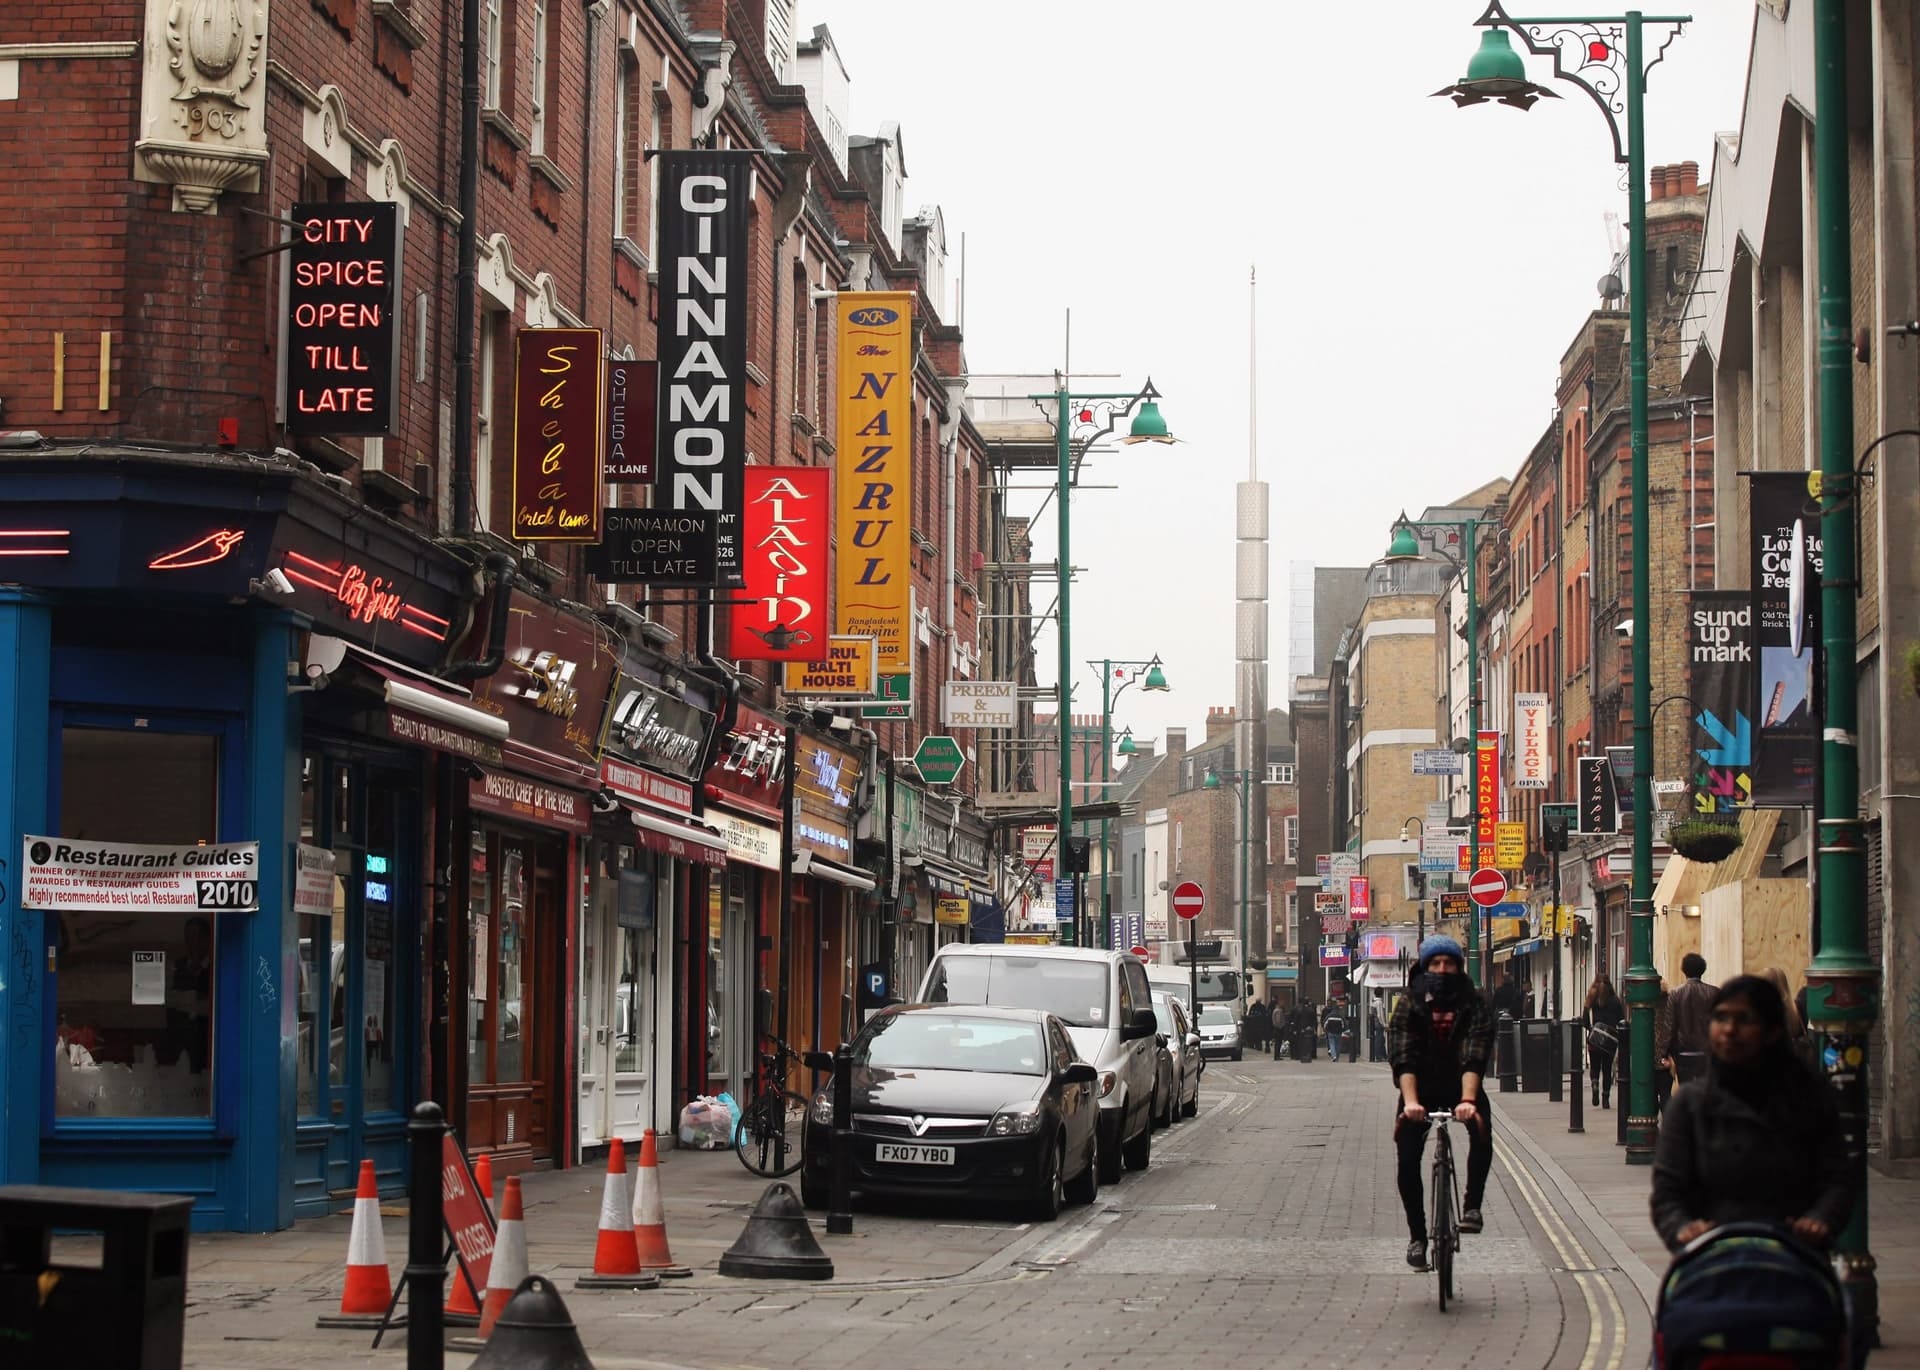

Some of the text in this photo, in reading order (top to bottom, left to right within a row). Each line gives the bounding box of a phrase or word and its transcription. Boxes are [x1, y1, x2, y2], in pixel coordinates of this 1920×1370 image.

[181, 106, 237, 138] 1903
[304, 218, 374, 243] CITY
[296, 260, 385, 286] SPICE
[296, 303, 379, 328] OPEN
[858, 310, 889, 324] NR
[670, 176, 730, 510] CINNAMON
[856, 344, 891, 356] The
[305, 345, 369, 371] TILL
[298, 388, 374, 412] LATE
[539, 346, 578, 500] Sheba
[612, 368, 626, 459] SHEBA
[620, 465, 648, 473] LANE
[850, 372, 897, 586] NAZRUL
[517, 505, 590, 528] brick lane
[608, 516, 705, 533] CINNAMON
[1777, 527, 1793, 537] Th
[632, 539, 681, 553] OPEN
[610, 559, 697, 575] TILL LATE
[338, 565, 368, 620] City
[848, 617, 899, 625] Bangladeshi
[1762, 620, 1784, 628] Brick
[848, 625, 899, 637] Cuisine
[1700, 626, 1731, 648] up
[808, 662, 851, 673] BALTI
[802, 676, 856, 687] HOUSE
[951, 685, 1010, 696] PREEM
[974, 699, 987, 710] &
[950, 712, 1011, 724] PRITHI
[1524, 709, 1540, 778] VILLAGE
[1518, 779, 1545, 787] OPEN
[485, 774, 514, 800] MASTER
[515, 781, 534, 805] CHEF
[535, 787, 545, 807] OF
[545, 790, 557, 811] THE
[558, 794, 574, 815] YEAR
[55, 844, 254, 867] Restaurant Guides
[29, 866, 63, 875] WINNER
[65, 868, 77, 876] OF
[80, 869, 97, 878] THE
[124, 871, 180, 879] RESTAURANT
[195, 871, 223, 879] BRICK
[225, 871, 247, 879] LANE
[29, 877, 180, 889] AWARDED BY RESTAURANT GUIDES
[29, 887, 196, 906] Highly recommended best local Restaurant
[201, 881, 254, 906] 2010
[871, 974, 883, 993] P
[882, 1145, 949, 1162] FX07 YBO
[455, 1222, 494, 1263] CLOSED
